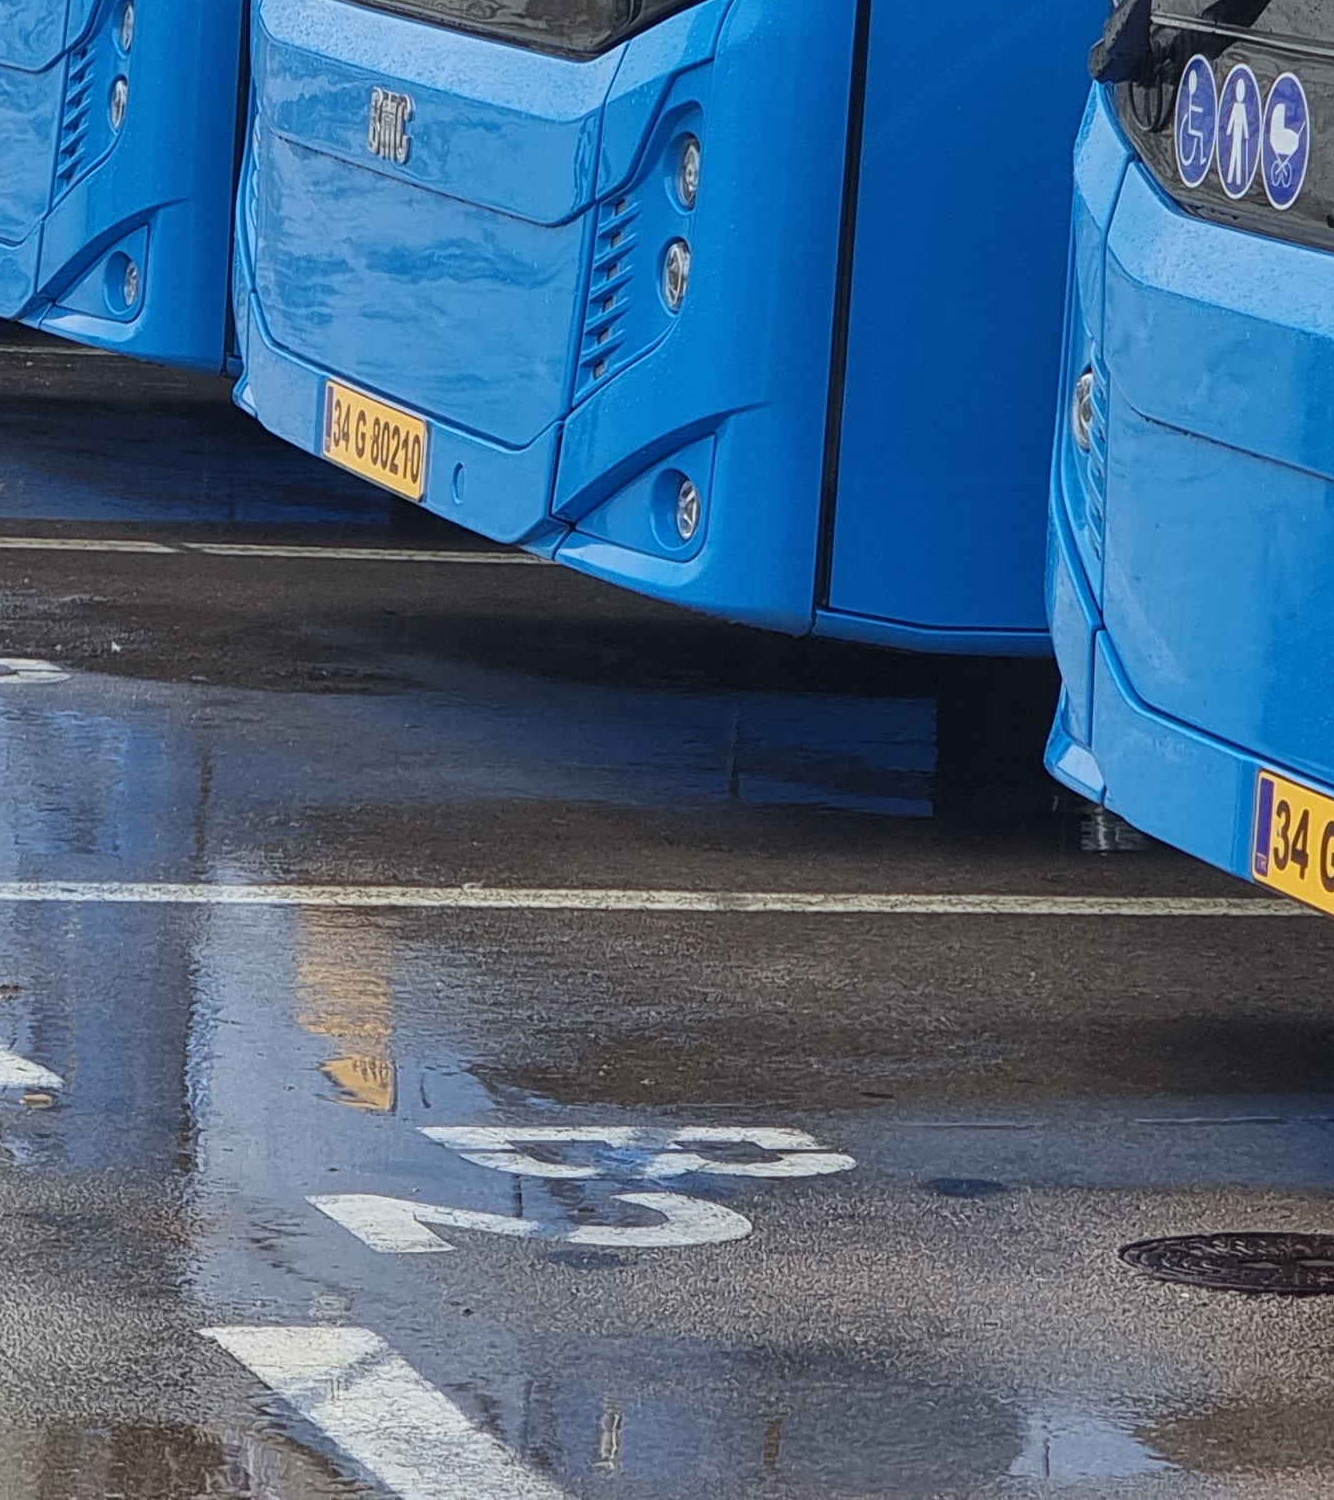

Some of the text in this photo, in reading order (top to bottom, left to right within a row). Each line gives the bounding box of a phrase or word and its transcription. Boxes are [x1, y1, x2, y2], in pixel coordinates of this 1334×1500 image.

[333, 398, 422, 484] 34 G 80210
[1273, 799, 1310, 881] 34
